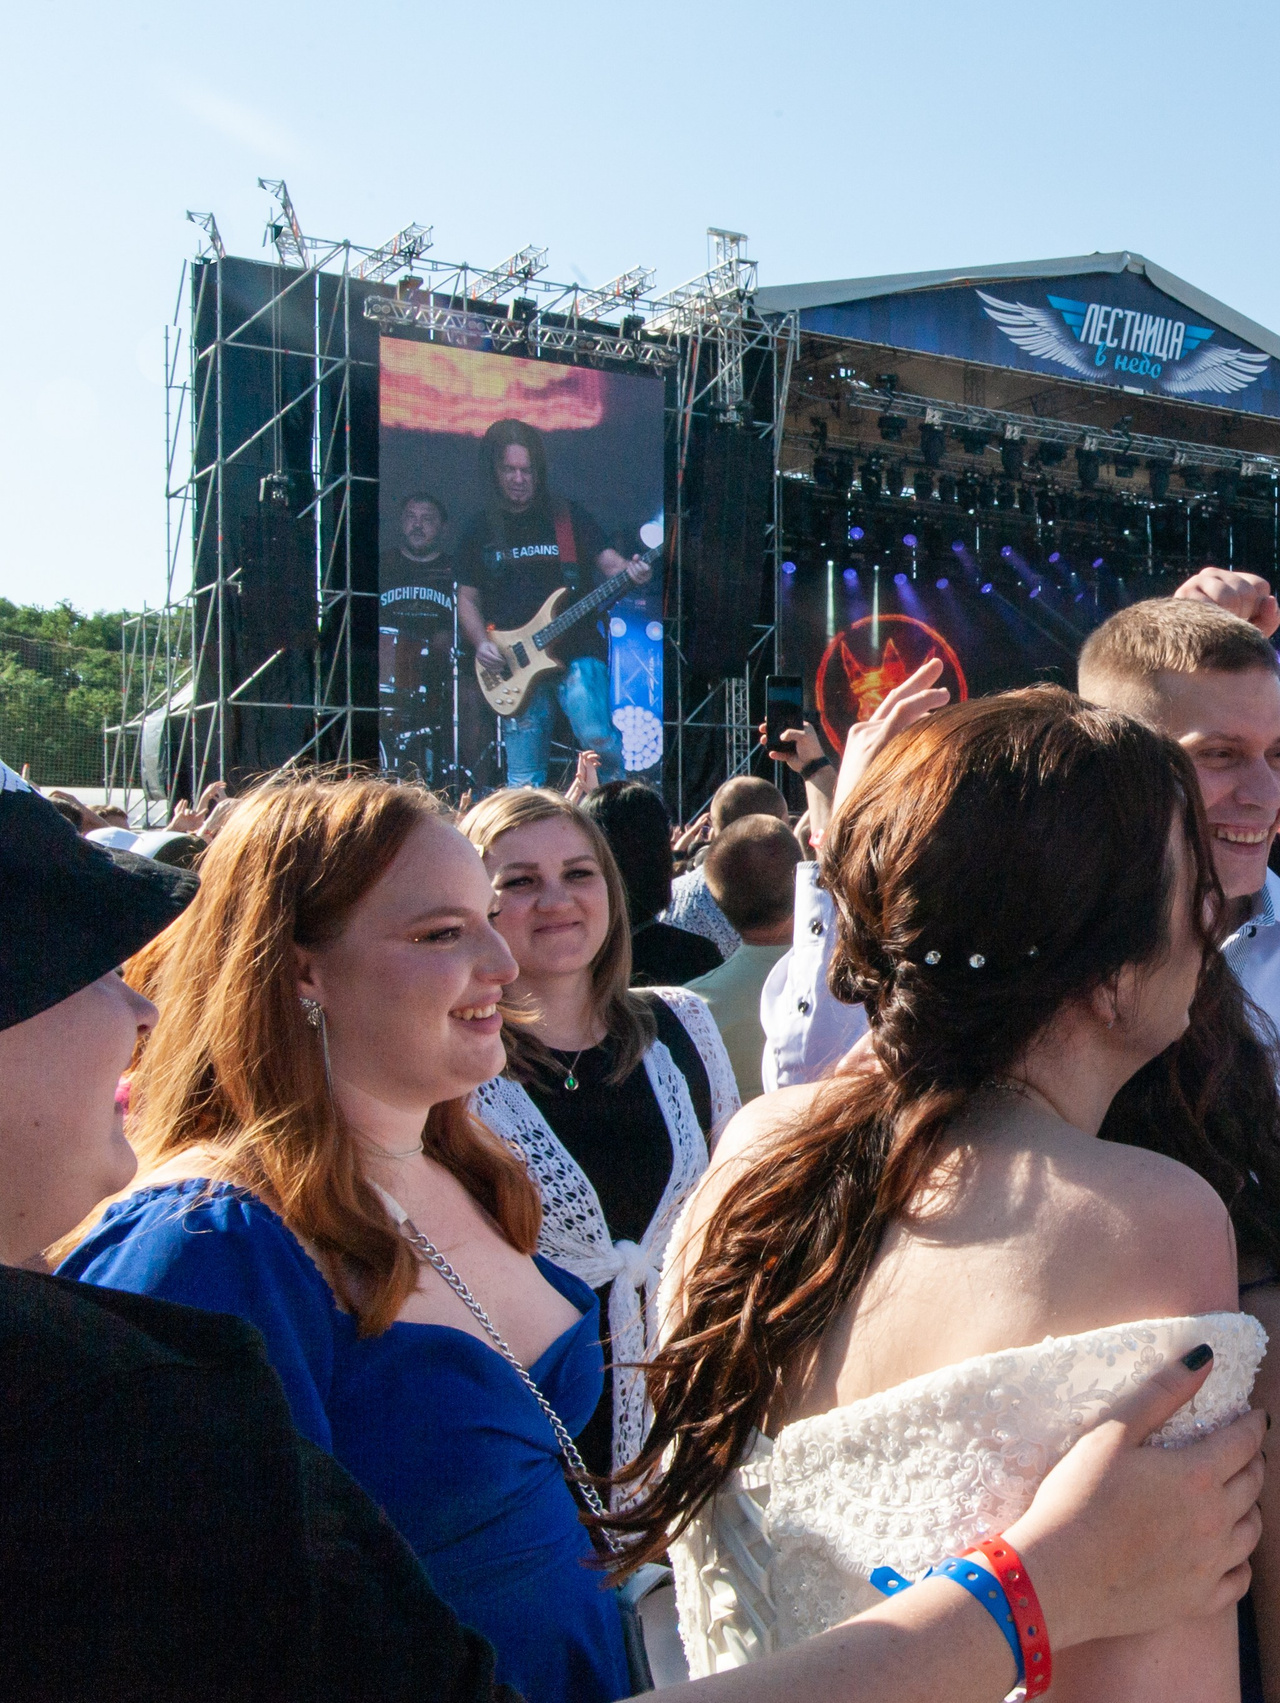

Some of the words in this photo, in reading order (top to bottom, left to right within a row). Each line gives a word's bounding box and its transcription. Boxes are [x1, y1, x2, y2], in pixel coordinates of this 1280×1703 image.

[1080, 303, 1186, 362] ЛЕСТНИЦА
[1094, 341, 1108, 367] в
[1114, 352, 1163, 379] небо
[520, 544, 560, 557] AGAINS
[380, 586, 453, 612] SOCHIFORNIA
